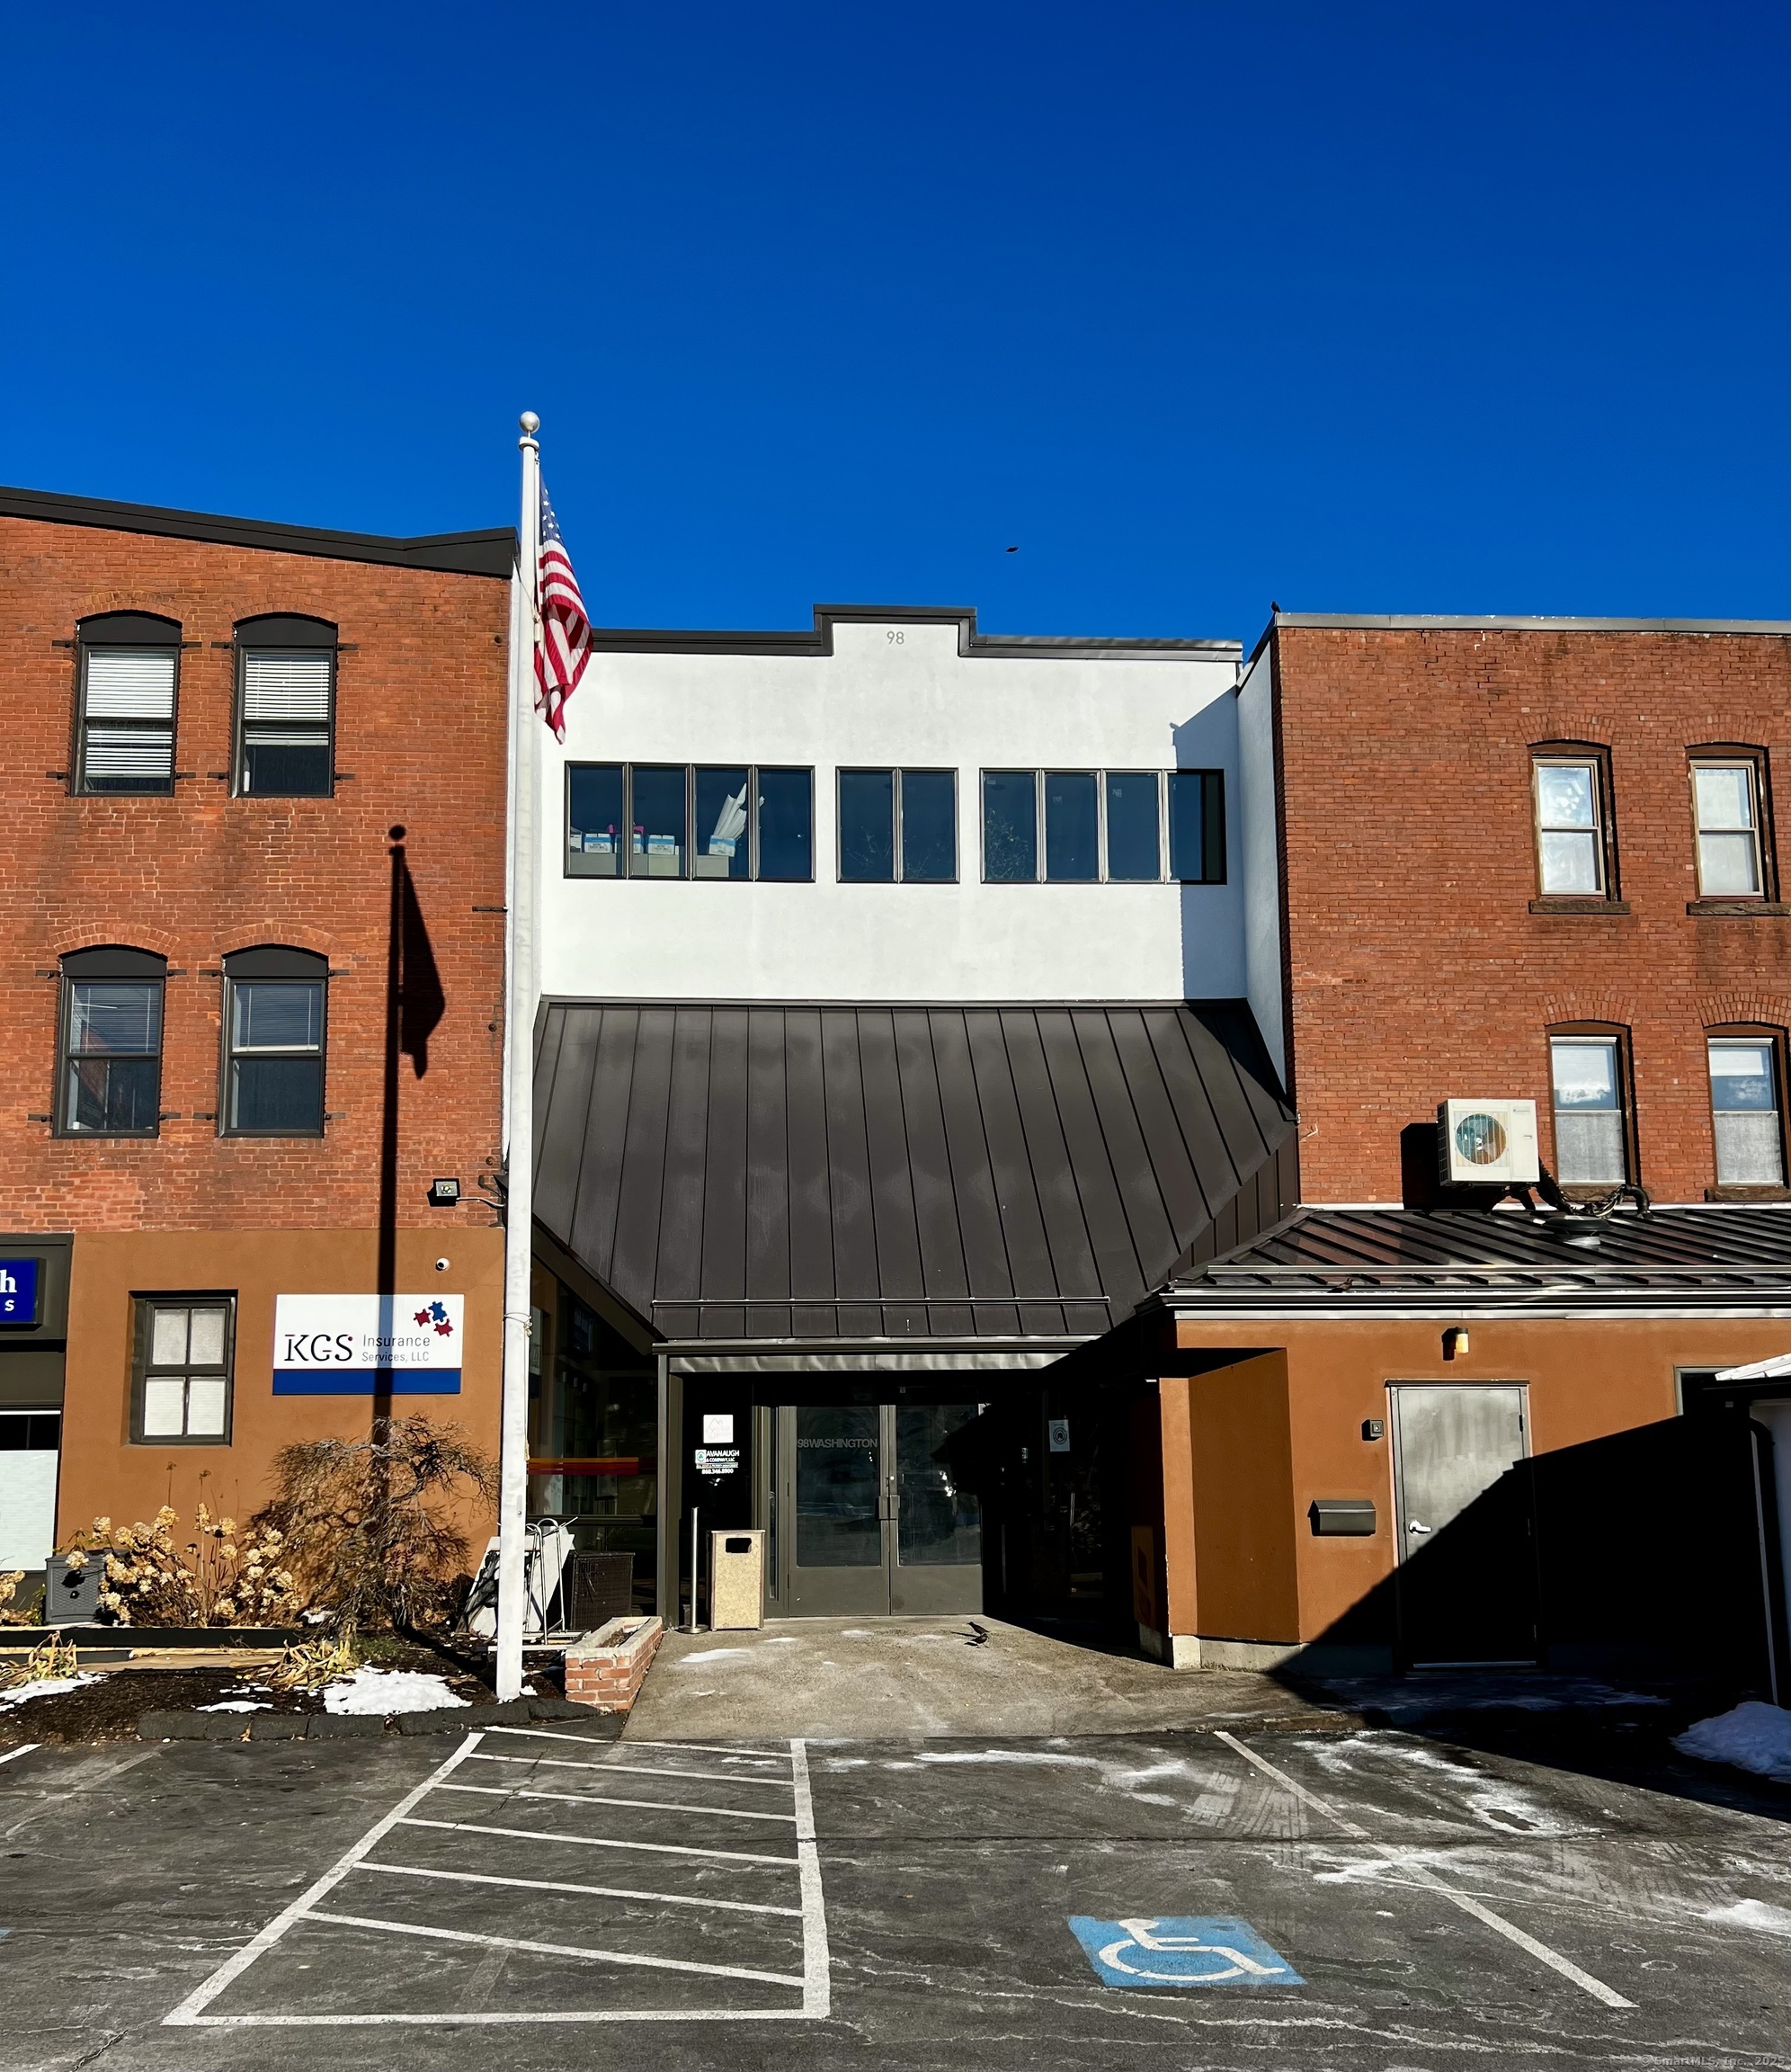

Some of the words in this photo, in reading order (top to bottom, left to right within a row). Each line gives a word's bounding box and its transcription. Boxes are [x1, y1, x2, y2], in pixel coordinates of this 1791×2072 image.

[887, 630, 904, 645] 98
[363, 1334, 431, 1347] Insurance
[284, 1334, 353, 1362] KGS
[361, 1352, 408, 1362] Services,
[411, 1352, 429, 1362] LLC
